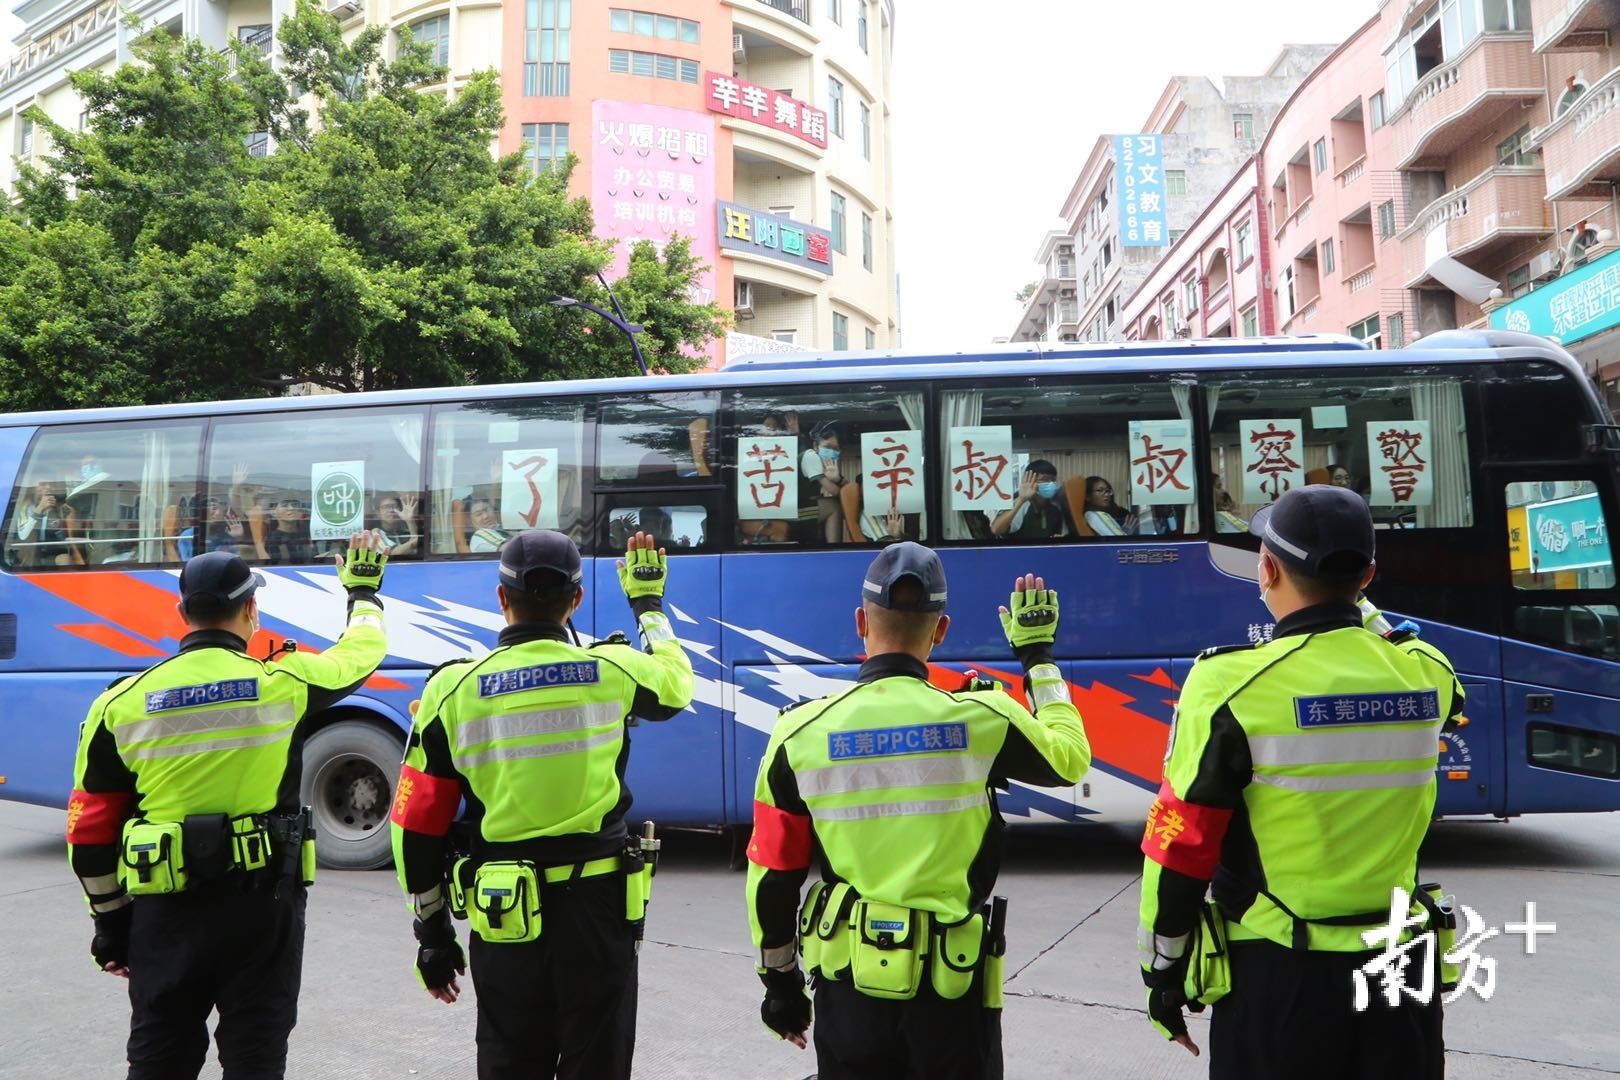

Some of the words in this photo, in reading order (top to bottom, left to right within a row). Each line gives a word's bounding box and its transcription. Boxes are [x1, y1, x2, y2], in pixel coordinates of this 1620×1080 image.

[599, 119, 710, 158] 火爆招租
[613, 166, 697, 194] 办公贸易
[1122, 136, 1139, 241] 82702666
[1137, 135, 1162, 242] 习文教育
[613, 201, 697, 228] 培训机构
[725, 207, 831, 264] 汪阳画室
[744, 443, 794, 508] 苦
[871, 436, 914, 508] 辛
[952, 439, 1012, 500] 叔
[1132, 434, 1190, 492] 叔
[1247, 422, 1301, 501] 察
[1376, 428, 1427, 503] 警
[507, 455, 549, 527] 了
[149, 681, 254, 710] 东莞PPC铁骑
[484, 664, 595, 694] 东莞PPC铁骑
[1307, 694, 1437, 722] 东莞PPC铁骑
[832, 725, 963, 756] 东莞PPC铁骑
